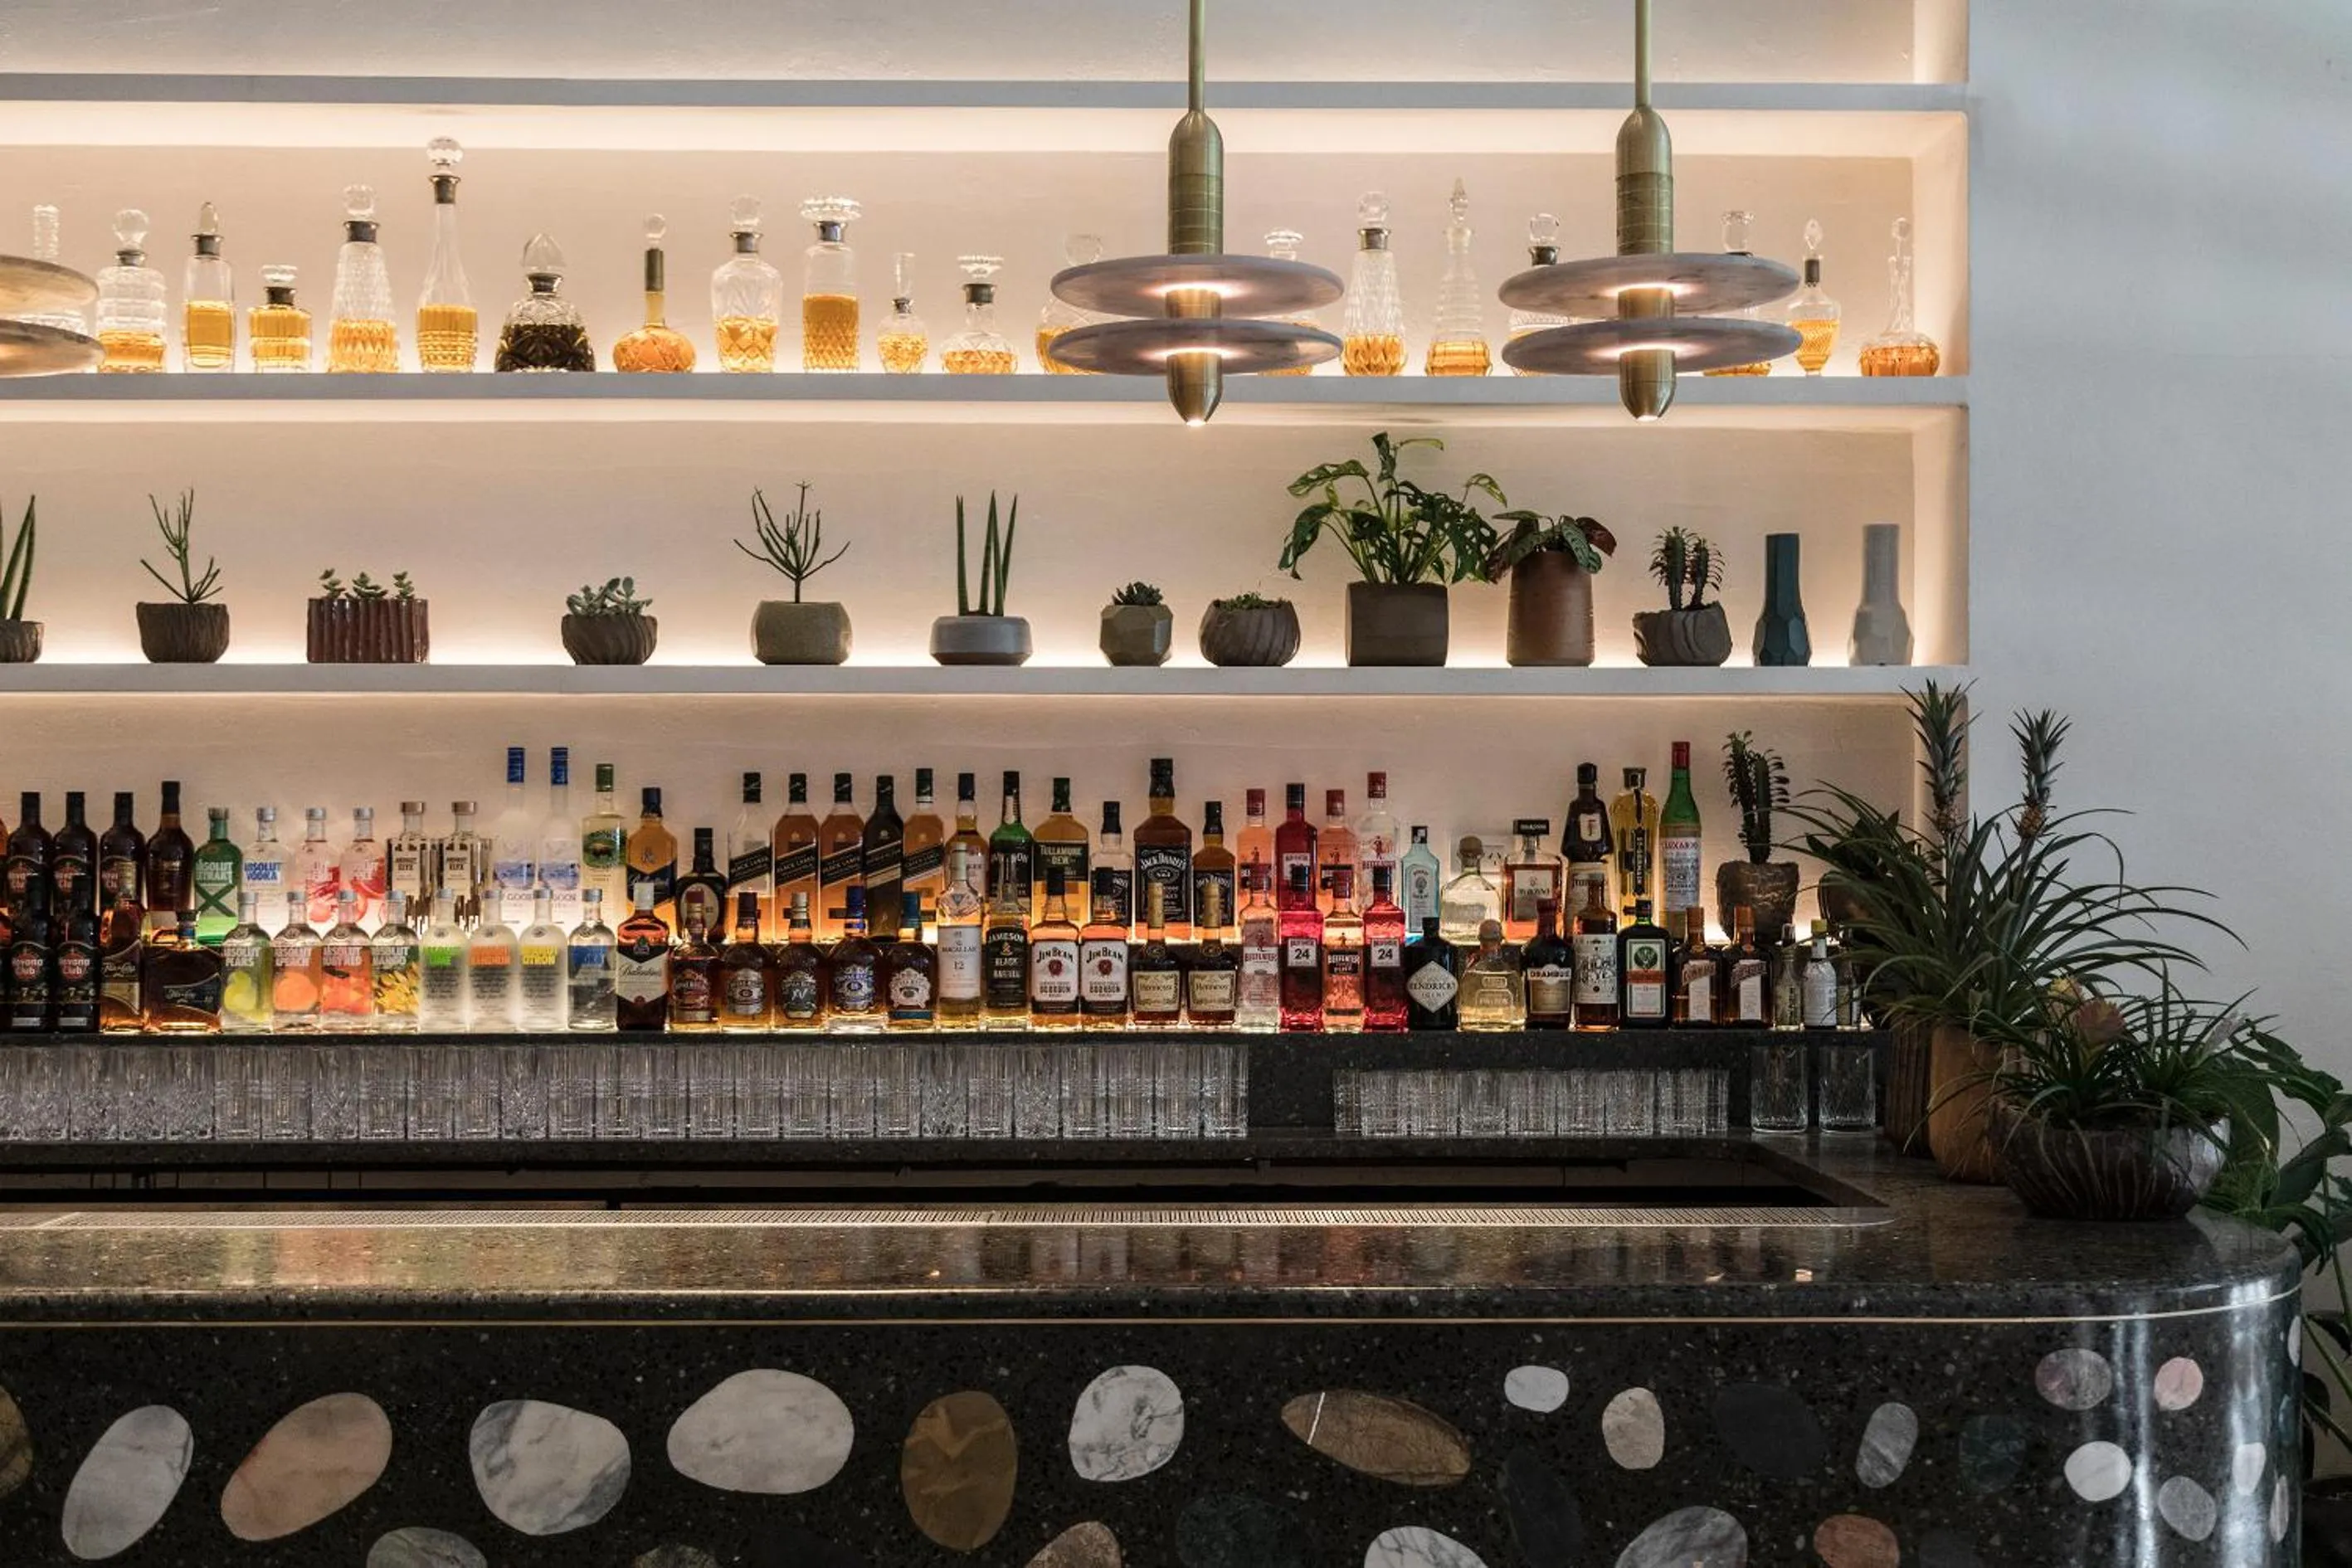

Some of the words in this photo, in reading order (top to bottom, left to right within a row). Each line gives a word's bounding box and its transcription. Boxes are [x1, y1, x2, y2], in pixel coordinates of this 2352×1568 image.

[1040, 845, 1082, 855] TULLAMORE
[244, 862, 280, 871] ABSOLUT
[1140, 856, 1158, 870] JACK
[246, 870, 277, 880] VODKA
[988, 933, 1025, 942] JAMESON
[1037, 950, 1051, 963] JIM
[1051, 947, 1074, 962] BEAM
[1086, 950, 1101, 963] JIM
[1102, 947, 1123, 962] BEAM
[1294, 948, 1310, 960] 24
[1378, 948, 1393, 960] 24
[226, 957, 255, 967] PEARS
[954, 961, 964, 970] 12
[996, 957, 1019, 966] BLACK
[20, 987, 28, 996] 7
[68, 987, 75, 996] 7
